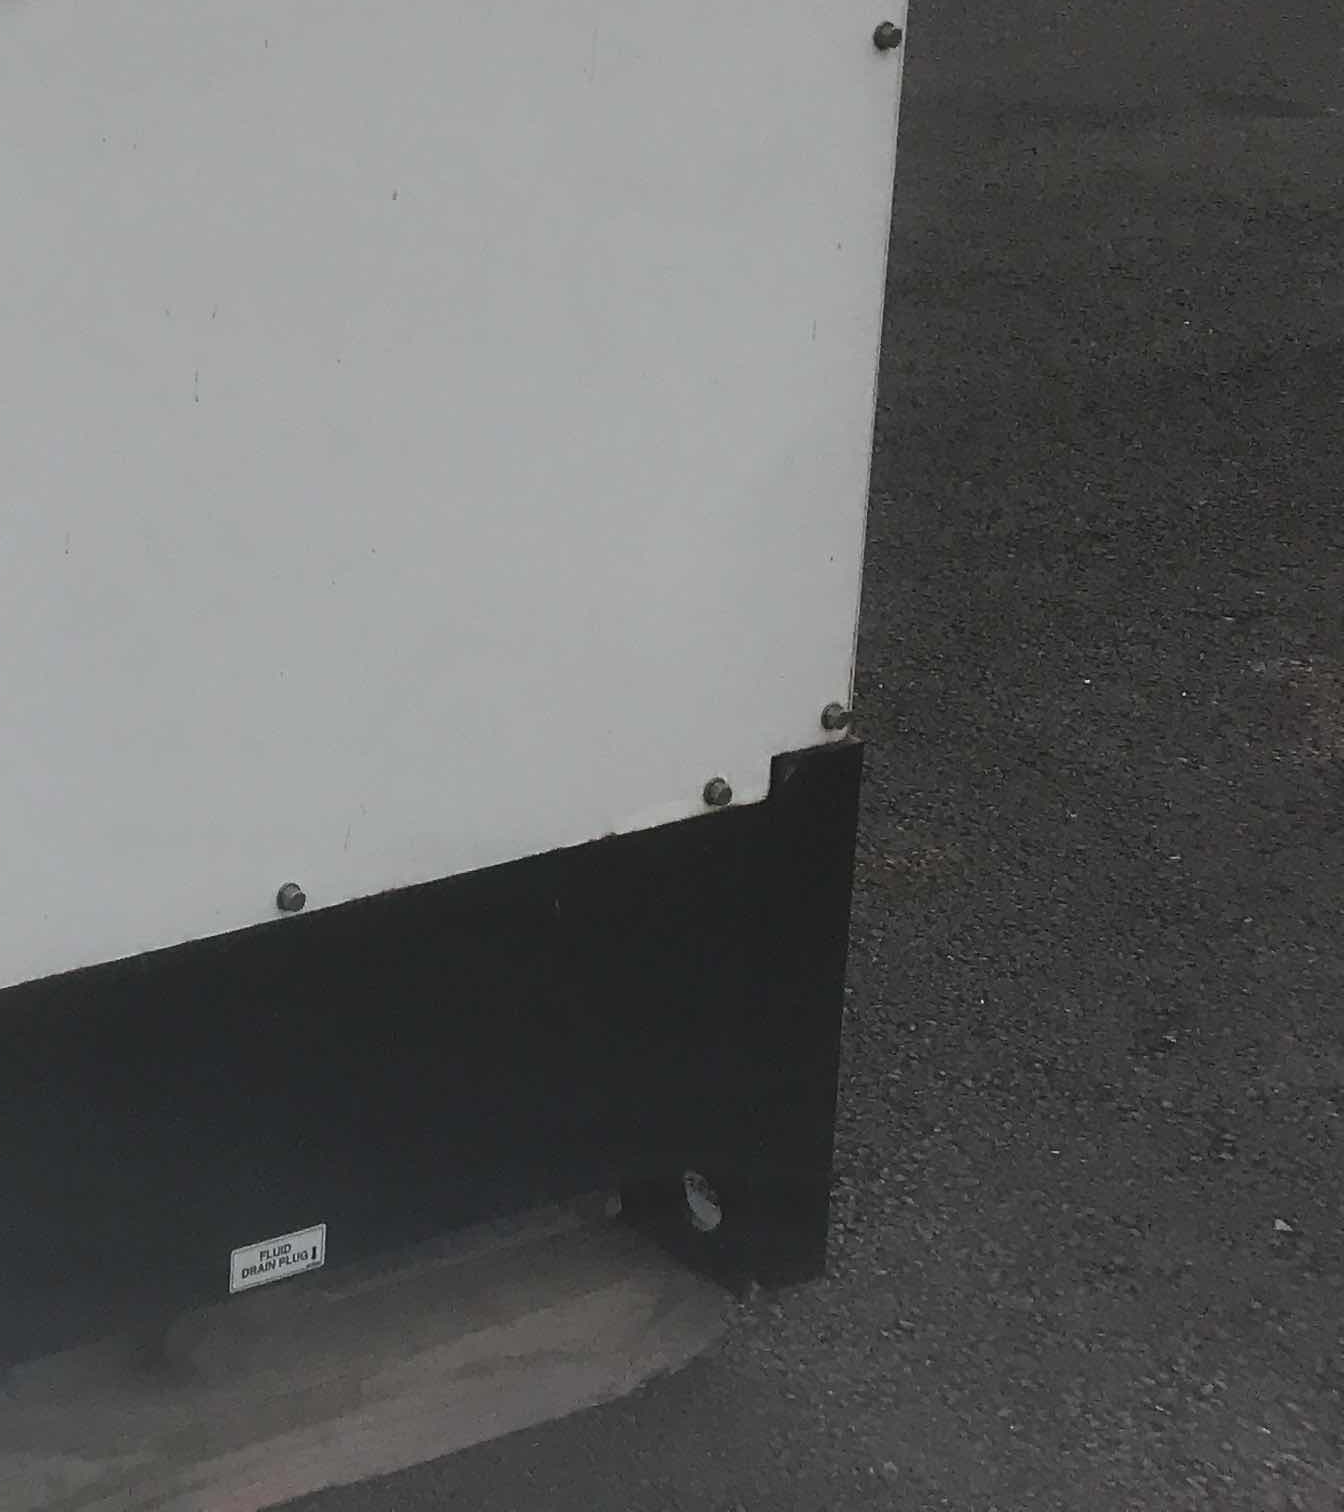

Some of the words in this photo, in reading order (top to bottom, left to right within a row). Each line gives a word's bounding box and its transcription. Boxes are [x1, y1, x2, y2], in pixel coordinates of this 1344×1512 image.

[241, 1259, 277, 1279] DRAIN
[278, 1250, 309, 1268] PLUG
[259, 1243, 292, 1262] FLUID
